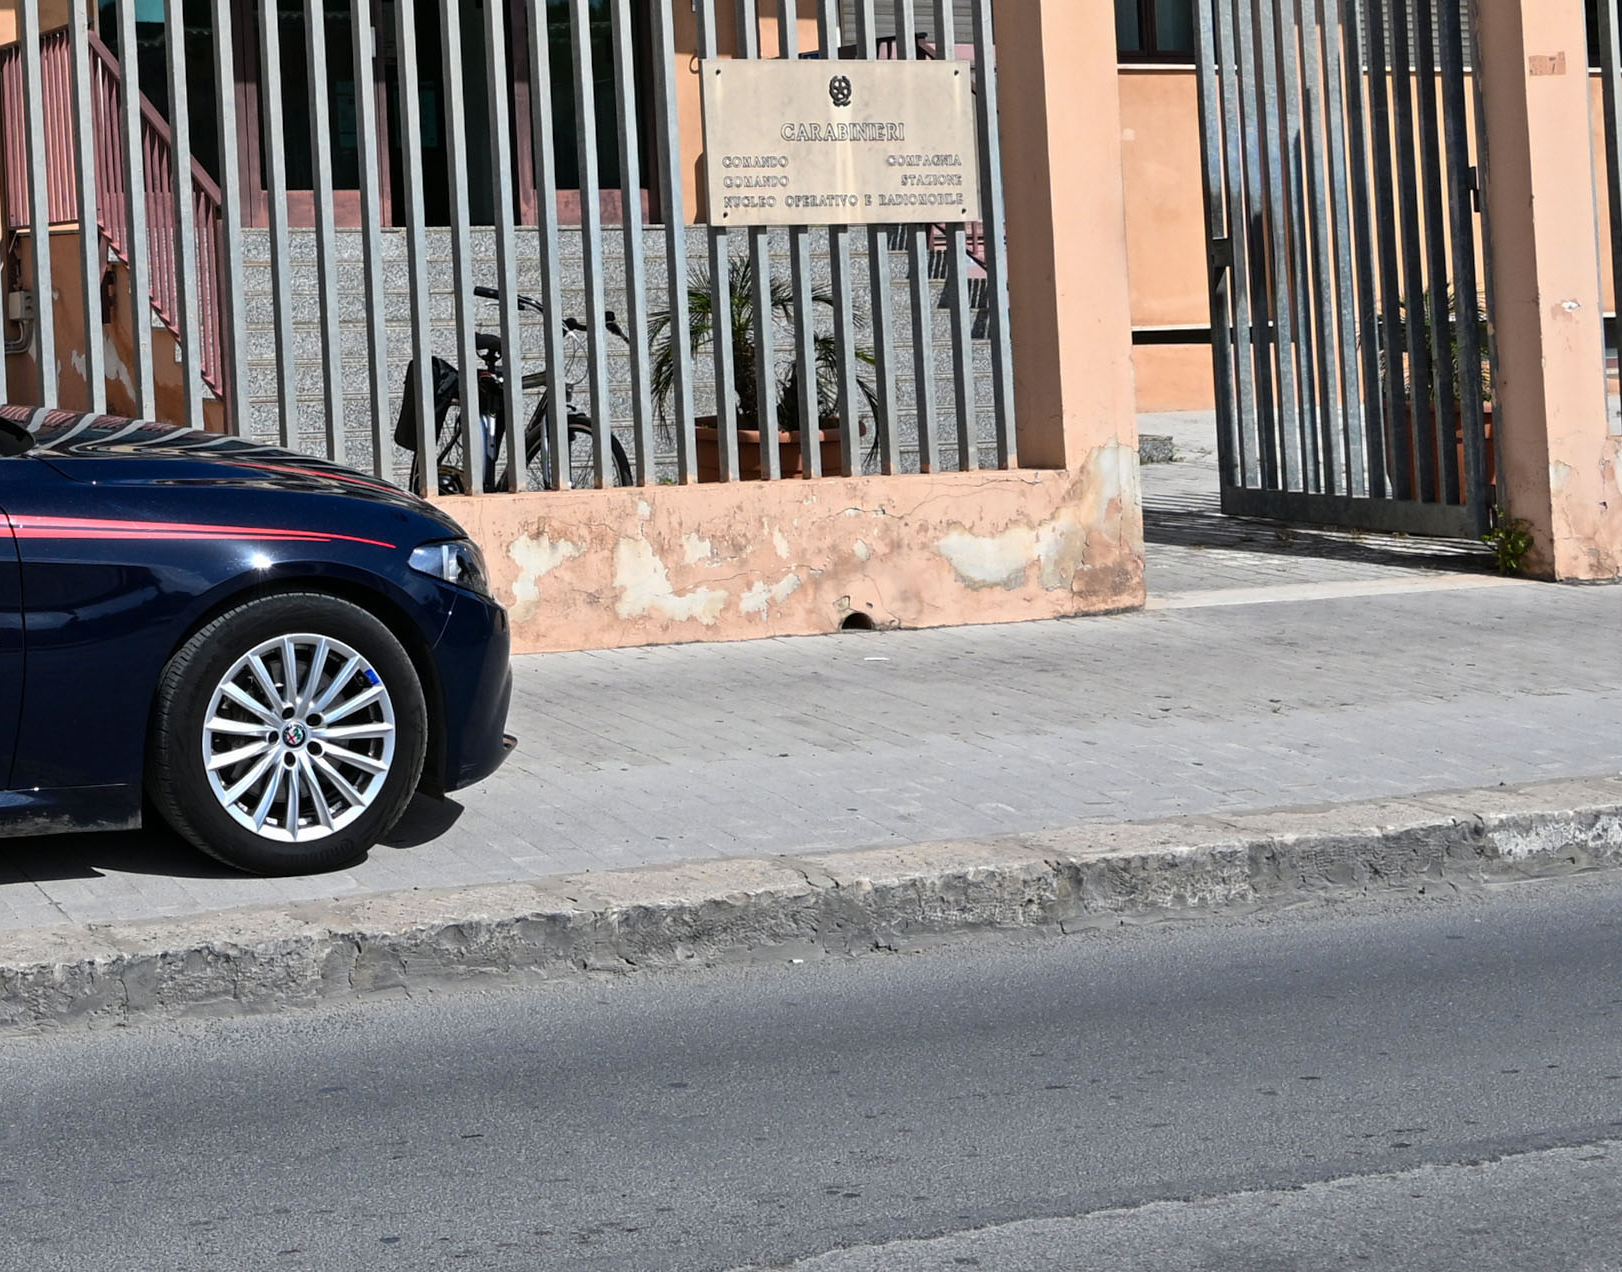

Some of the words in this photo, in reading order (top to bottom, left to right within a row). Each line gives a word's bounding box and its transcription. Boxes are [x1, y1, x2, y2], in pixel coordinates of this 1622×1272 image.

[780, 122, 906, 142] CARABINIERI
[722, 155, 790, 169] COMANDO
[885, 154, 962, 168] COMPAGNIA
[723, 175, 790, 188] COMANDO
[900, 174, 963, 187] STAZIONE
[724, 196, 777, 209] NUCLEO
[784, 194, 859, 208] OPERATIVO
[865, 194, 873, 207] E
[879, 192, 964, 206] RADIOMOBILE
